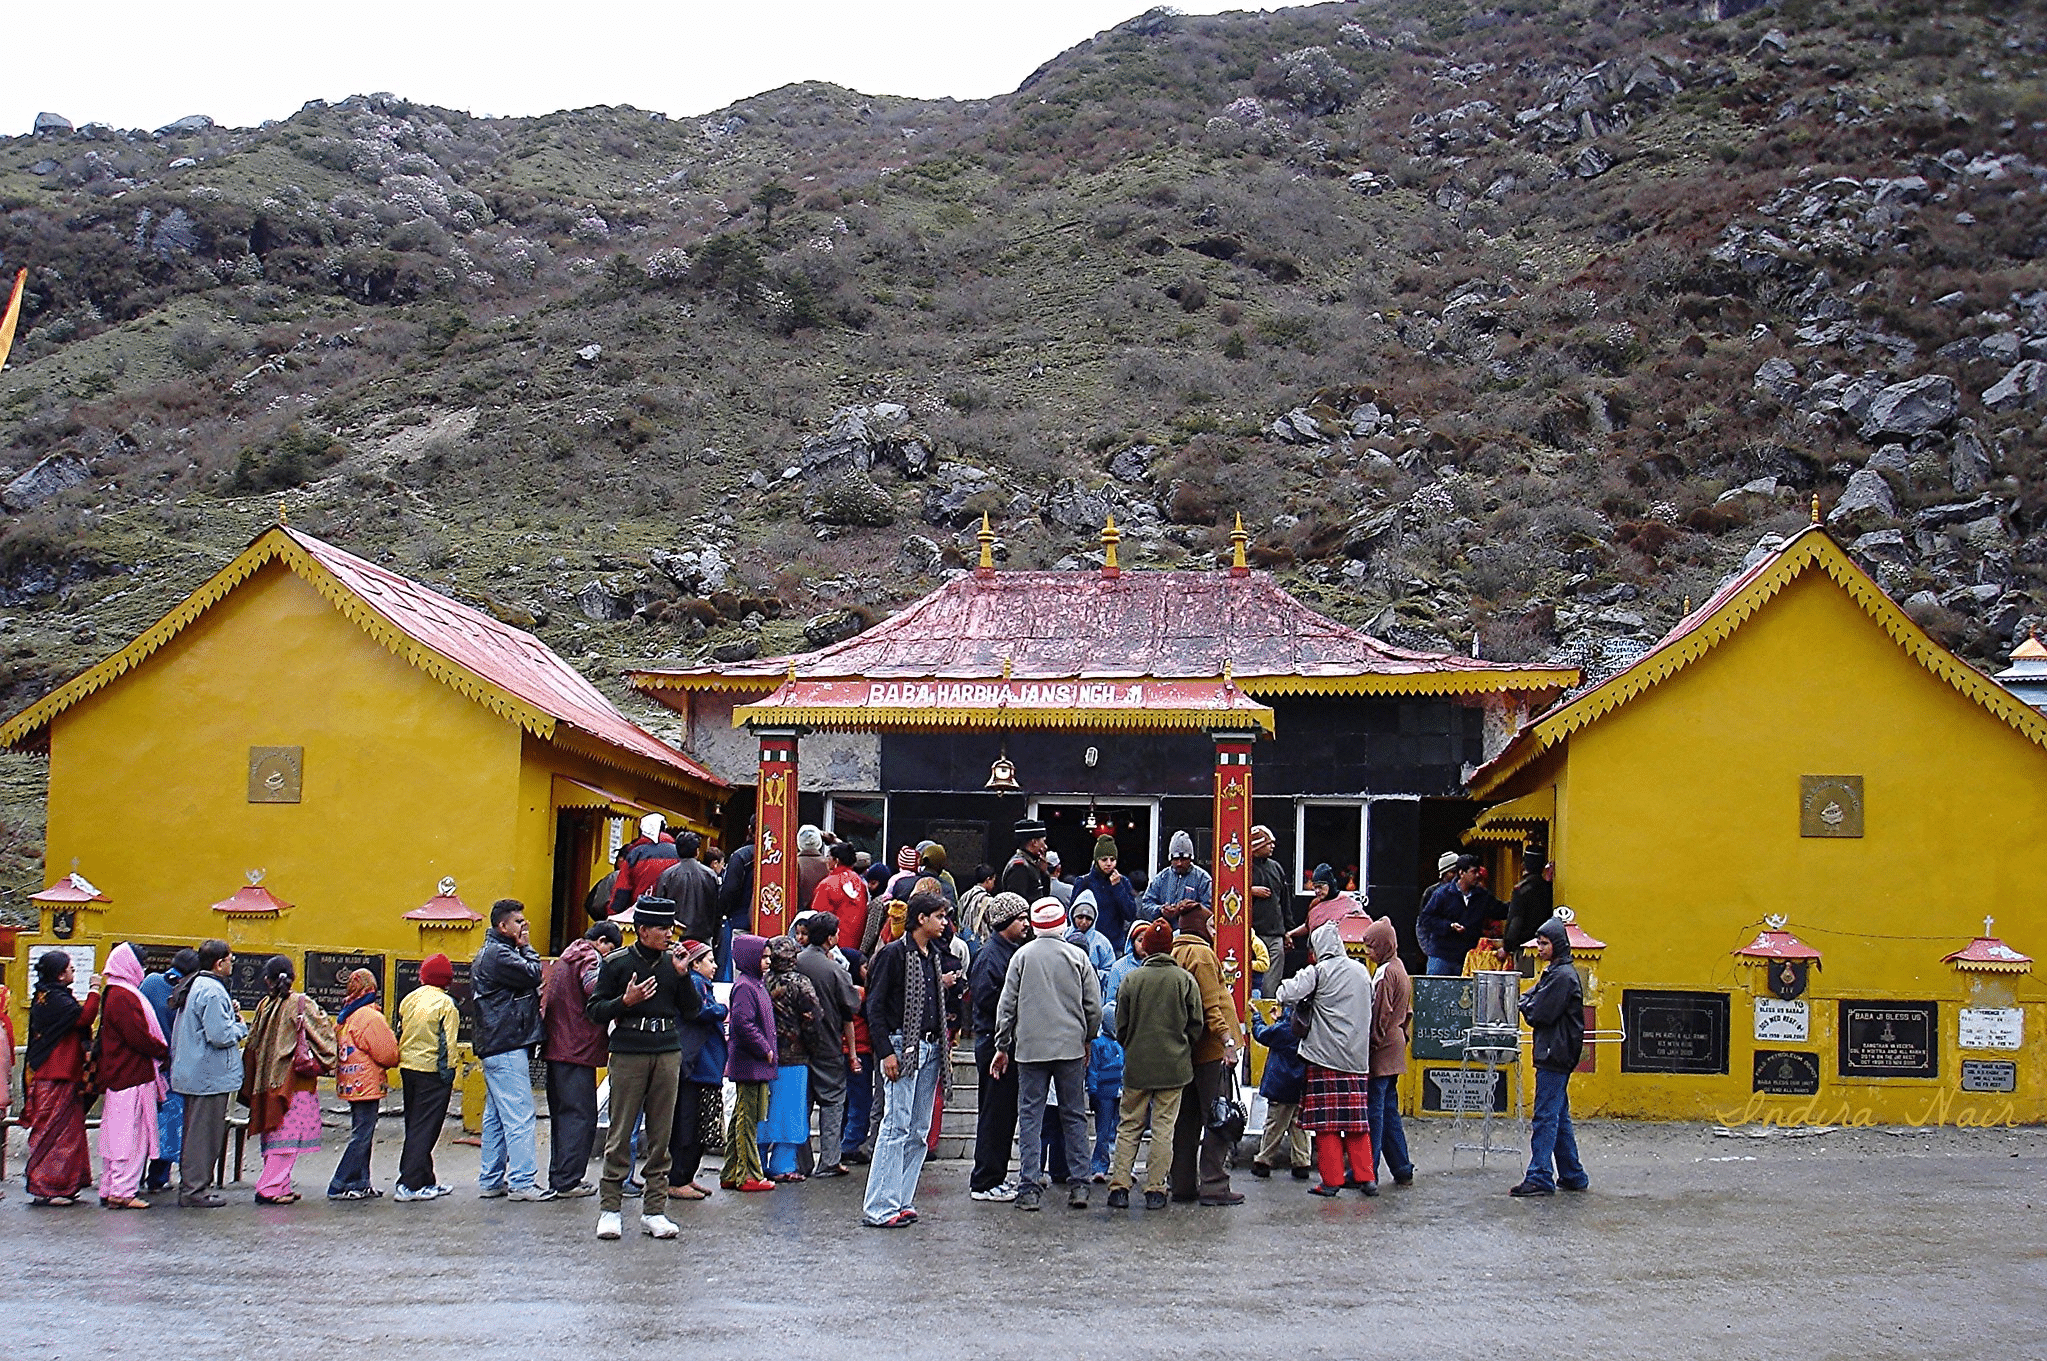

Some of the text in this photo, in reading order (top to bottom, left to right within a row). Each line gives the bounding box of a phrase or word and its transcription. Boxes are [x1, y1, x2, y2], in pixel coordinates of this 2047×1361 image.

[868, 683, 928, 704] BABA
[1855, 1012, 1874, 1020] BABA
[1885, 1013, 1909, 1021] BLESS
[1417, 1028, 1451, 1039] BLESS
